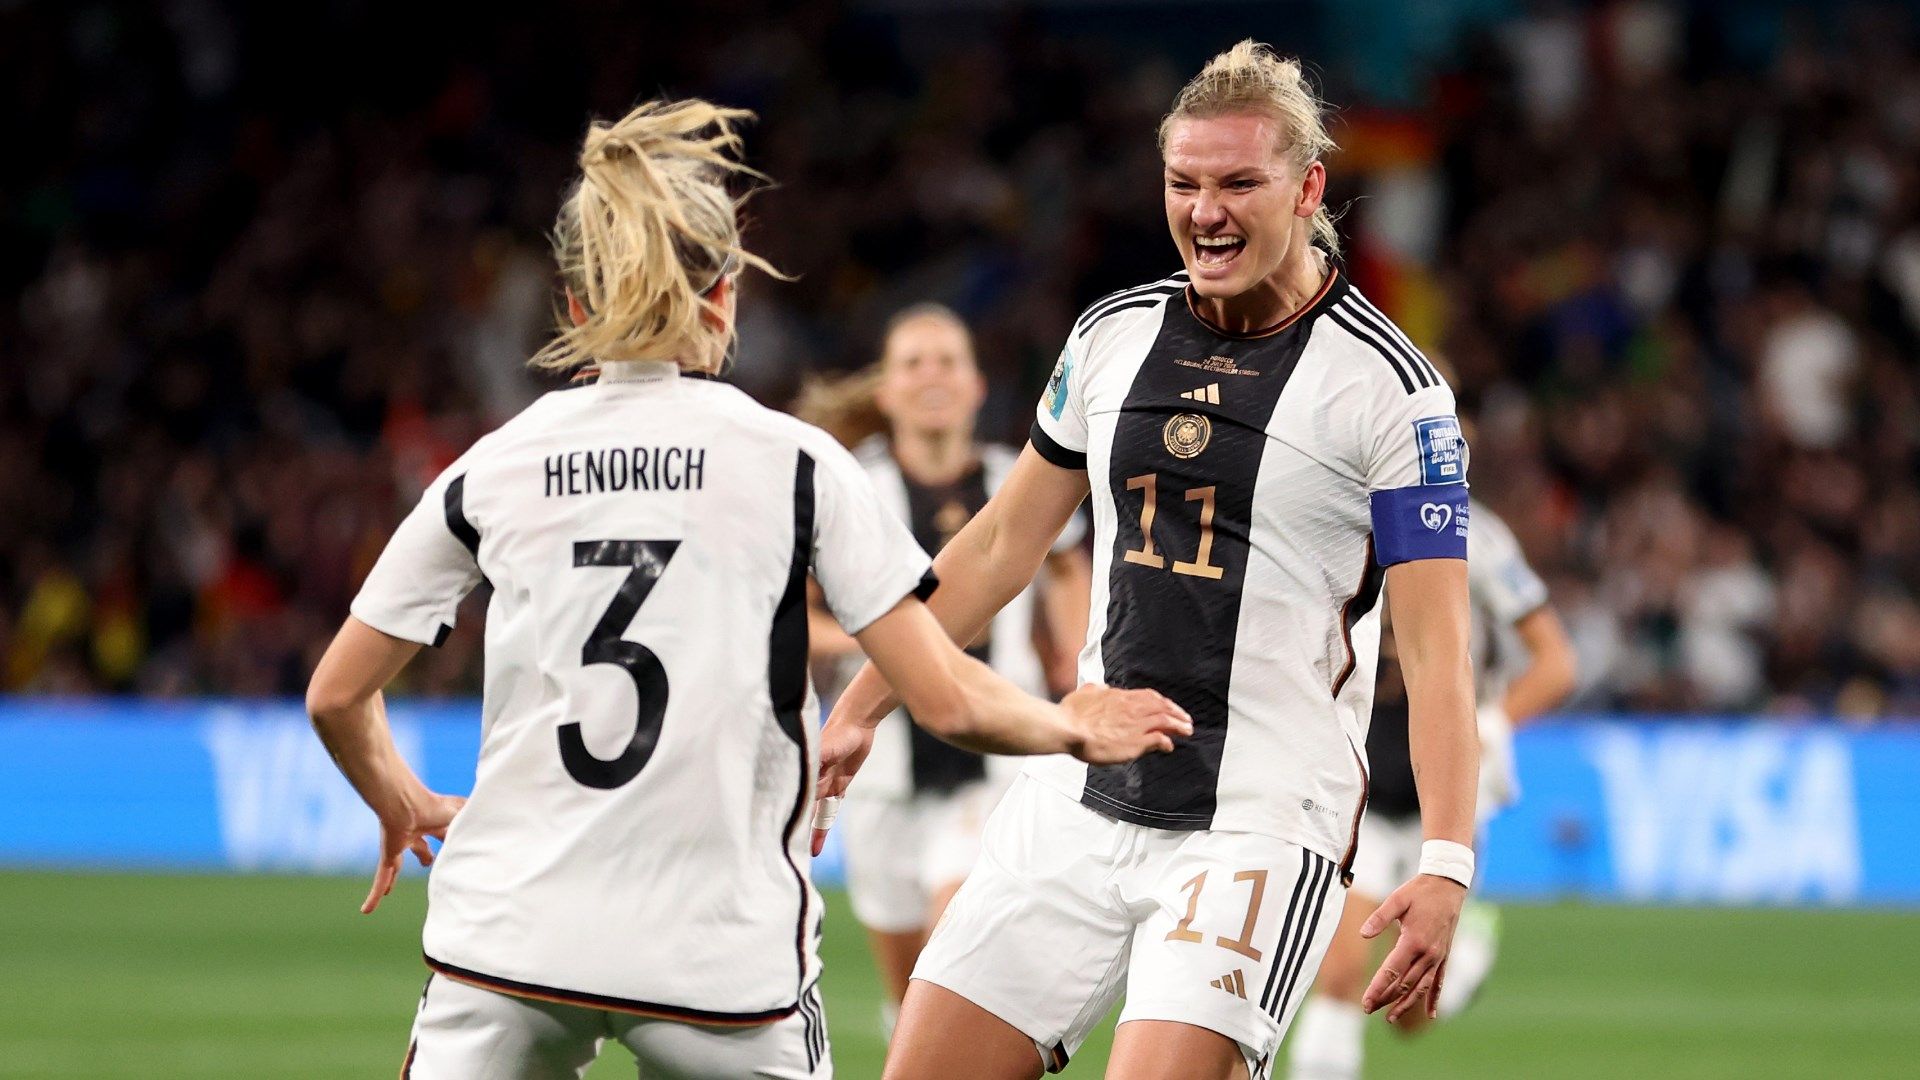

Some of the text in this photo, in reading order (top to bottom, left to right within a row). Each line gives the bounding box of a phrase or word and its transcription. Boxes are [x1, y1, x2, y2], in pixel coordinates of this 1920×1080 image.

[545, 447, 706, 497] HENDRICH
[1124, 473, 1223, 580] 11
[557, 540, 683, 790] 3
[1592, 727, 1860, 900] VISA
[1164, 869, 1268, 963] 11
